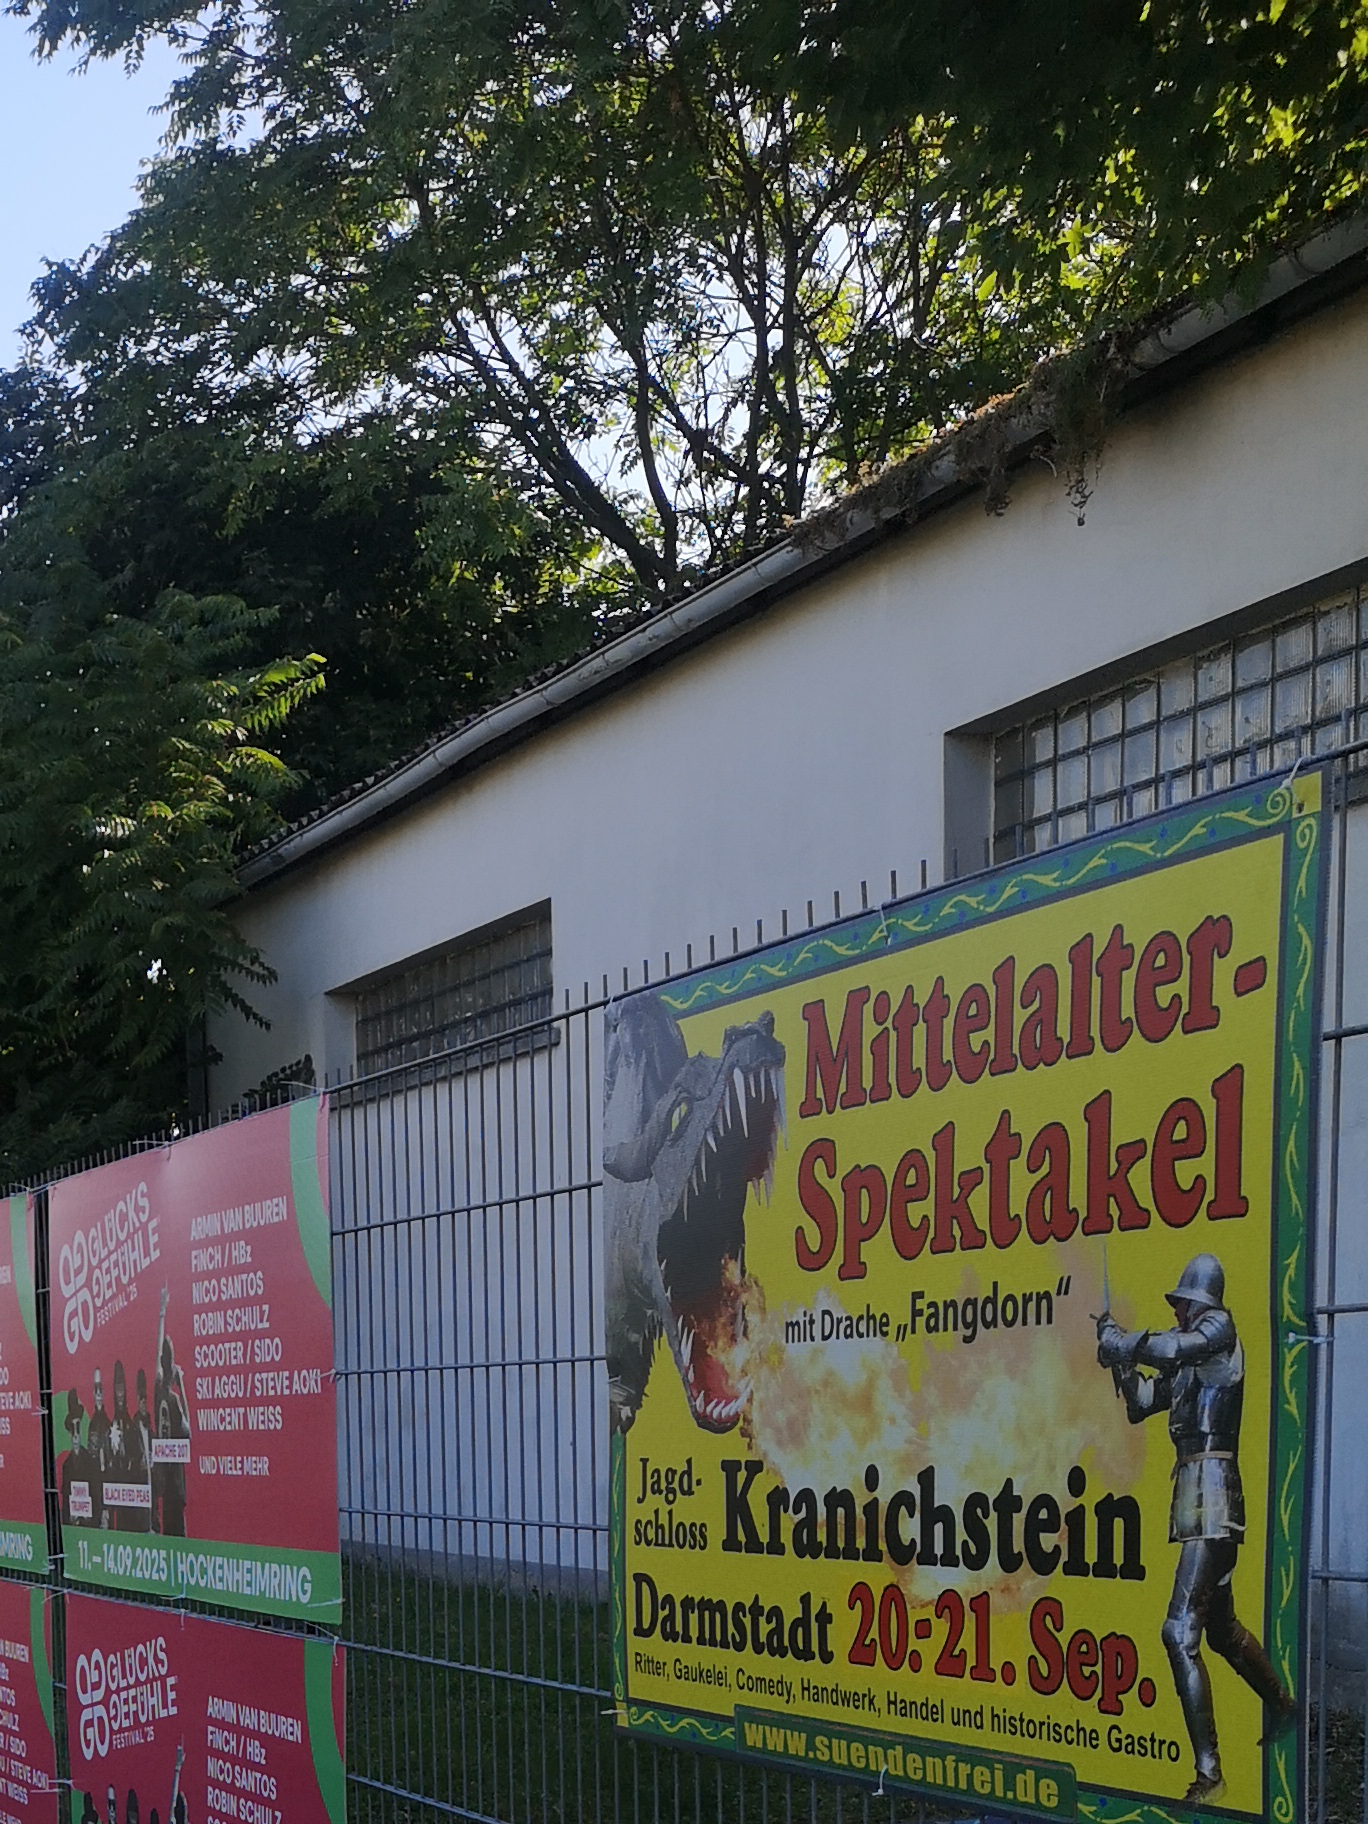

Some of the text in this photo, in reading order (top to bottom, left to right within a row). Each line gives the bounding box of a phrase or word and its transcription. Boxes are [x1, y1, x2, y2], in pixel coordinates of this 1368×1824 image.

[798, 914, 1268, 1120] Mittelalter-
[794, 1063, 1249, 1282] Spektakel
[190, 1195, 287, 1241] ARMIN VAN BUUREN
[192, 1270, 264, 1305] NICO SANTOS
[96, 1303, 128, 1328] FESTIVAL
[193, 1303, 270, 1337] ROBIN SCHULZ
[784, 1309, 816, 1344] mit
[821, 1303, 890, 1342] Drache
[194, 1341, 244, 1368] SCOOTER
[253, 1336, 282, 1364] SIDO
[195, 1376, 213, 1400] SKI
[213, 1374, 245, 1399] AGGU
[254, 1370, 290, 1397] STEVE
[292, 1368, 323, 1395] AOKI
[196, 1405, 283, 1431] WINCENT WEISS
[199, 1455, 269, 1476] UND VIELE MEHR
[636, 1457, 702, 1506] Jagd-
[633, 1508, 708, 1551] schloss
[720, 1459, 1146, 1581] Kranichstein
[176, 1551, 312, 1604] HOCKENHEIMRING
[632, 1572, 835, 1665] Darmstadt
[1027, 1595, 1157, 1717] Sep.
[206, 1695, 302, 1744] ARMIN VAN BUUREN
[634, 1650, 1180, 1763] Ritter, Gaukelei, Comedy, Handwerk, Handel und historische Gastro
[112, 1729, 144, 1750] FESTIVAL
[207, 1755, 277, 1801] NICO SANTOS
[744, 1722, 1058, 1808] www.suendenfrei.de
[207, 1785, 238, 1817] ROBIN
